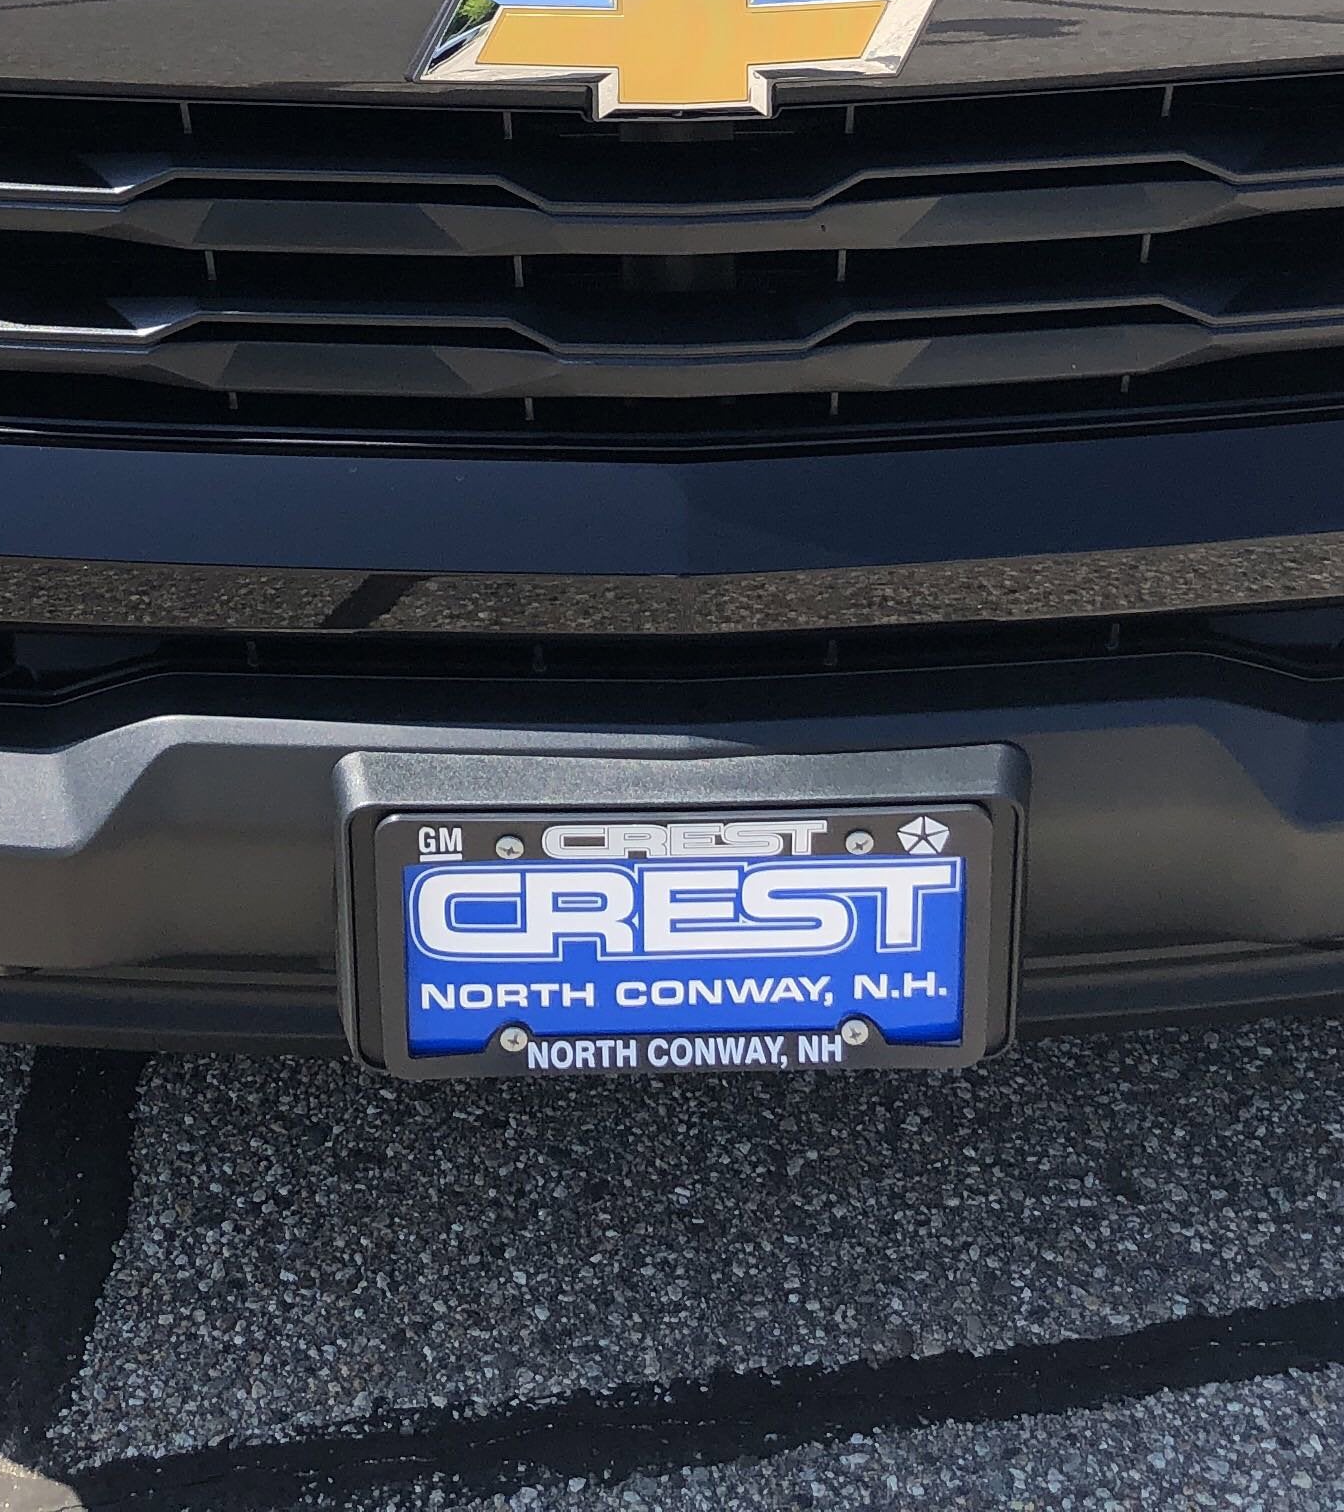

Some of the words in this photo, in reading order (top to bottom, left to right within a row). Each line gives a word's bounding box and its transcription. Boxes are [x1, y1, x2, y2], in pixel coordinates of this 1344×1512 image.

[418, 826, 463, 854] GM
[542, 820, 828, 859] CREST
[409, 856, 961, 962] CREST
[420, 982, 595, 1010] NORTH
[615, 975, 834, 1007] CONWAY,
[853, 971, 948, 1000] N.H.
[527, 1038, 638, 1070] NORTH
[647, 1035, 788, 1070] CONWAY,
[798, 1034, 843, 1064] NH
